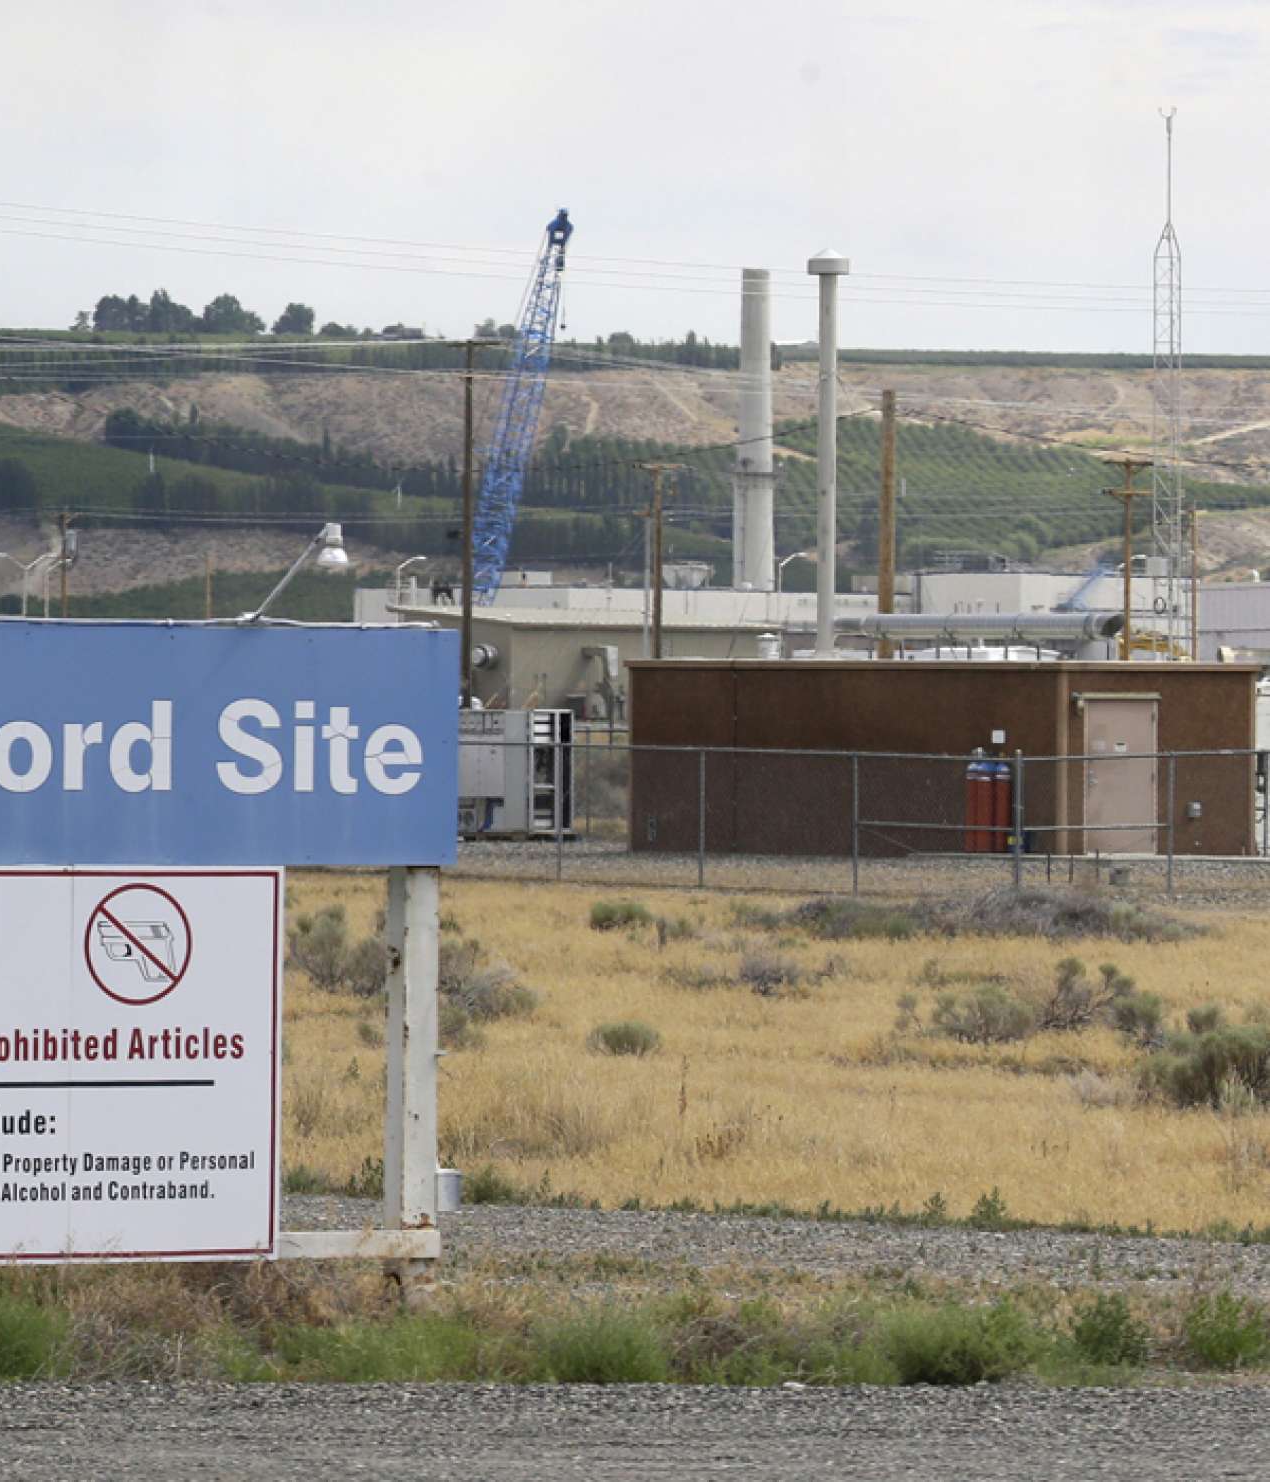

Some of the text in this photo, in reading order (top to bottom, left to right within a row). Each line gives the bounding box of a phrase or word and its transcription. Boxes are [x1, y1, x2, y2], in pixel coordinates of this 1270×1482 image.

[216, 698, 423, 795] Site
[128, 1026, 244, 1060] Articles
[3, 1153, 78, 1178] Property
[83, 1152, 152, 1176] Damage
[156, 1155, 174, 1172] or
[179, 1151, 255, 1171] Personal
[1, 1182, 67, 1202] Alcohol
[71, 1181, 103, 1201] and
[107, 1180, 215, 1201] Contraband.
